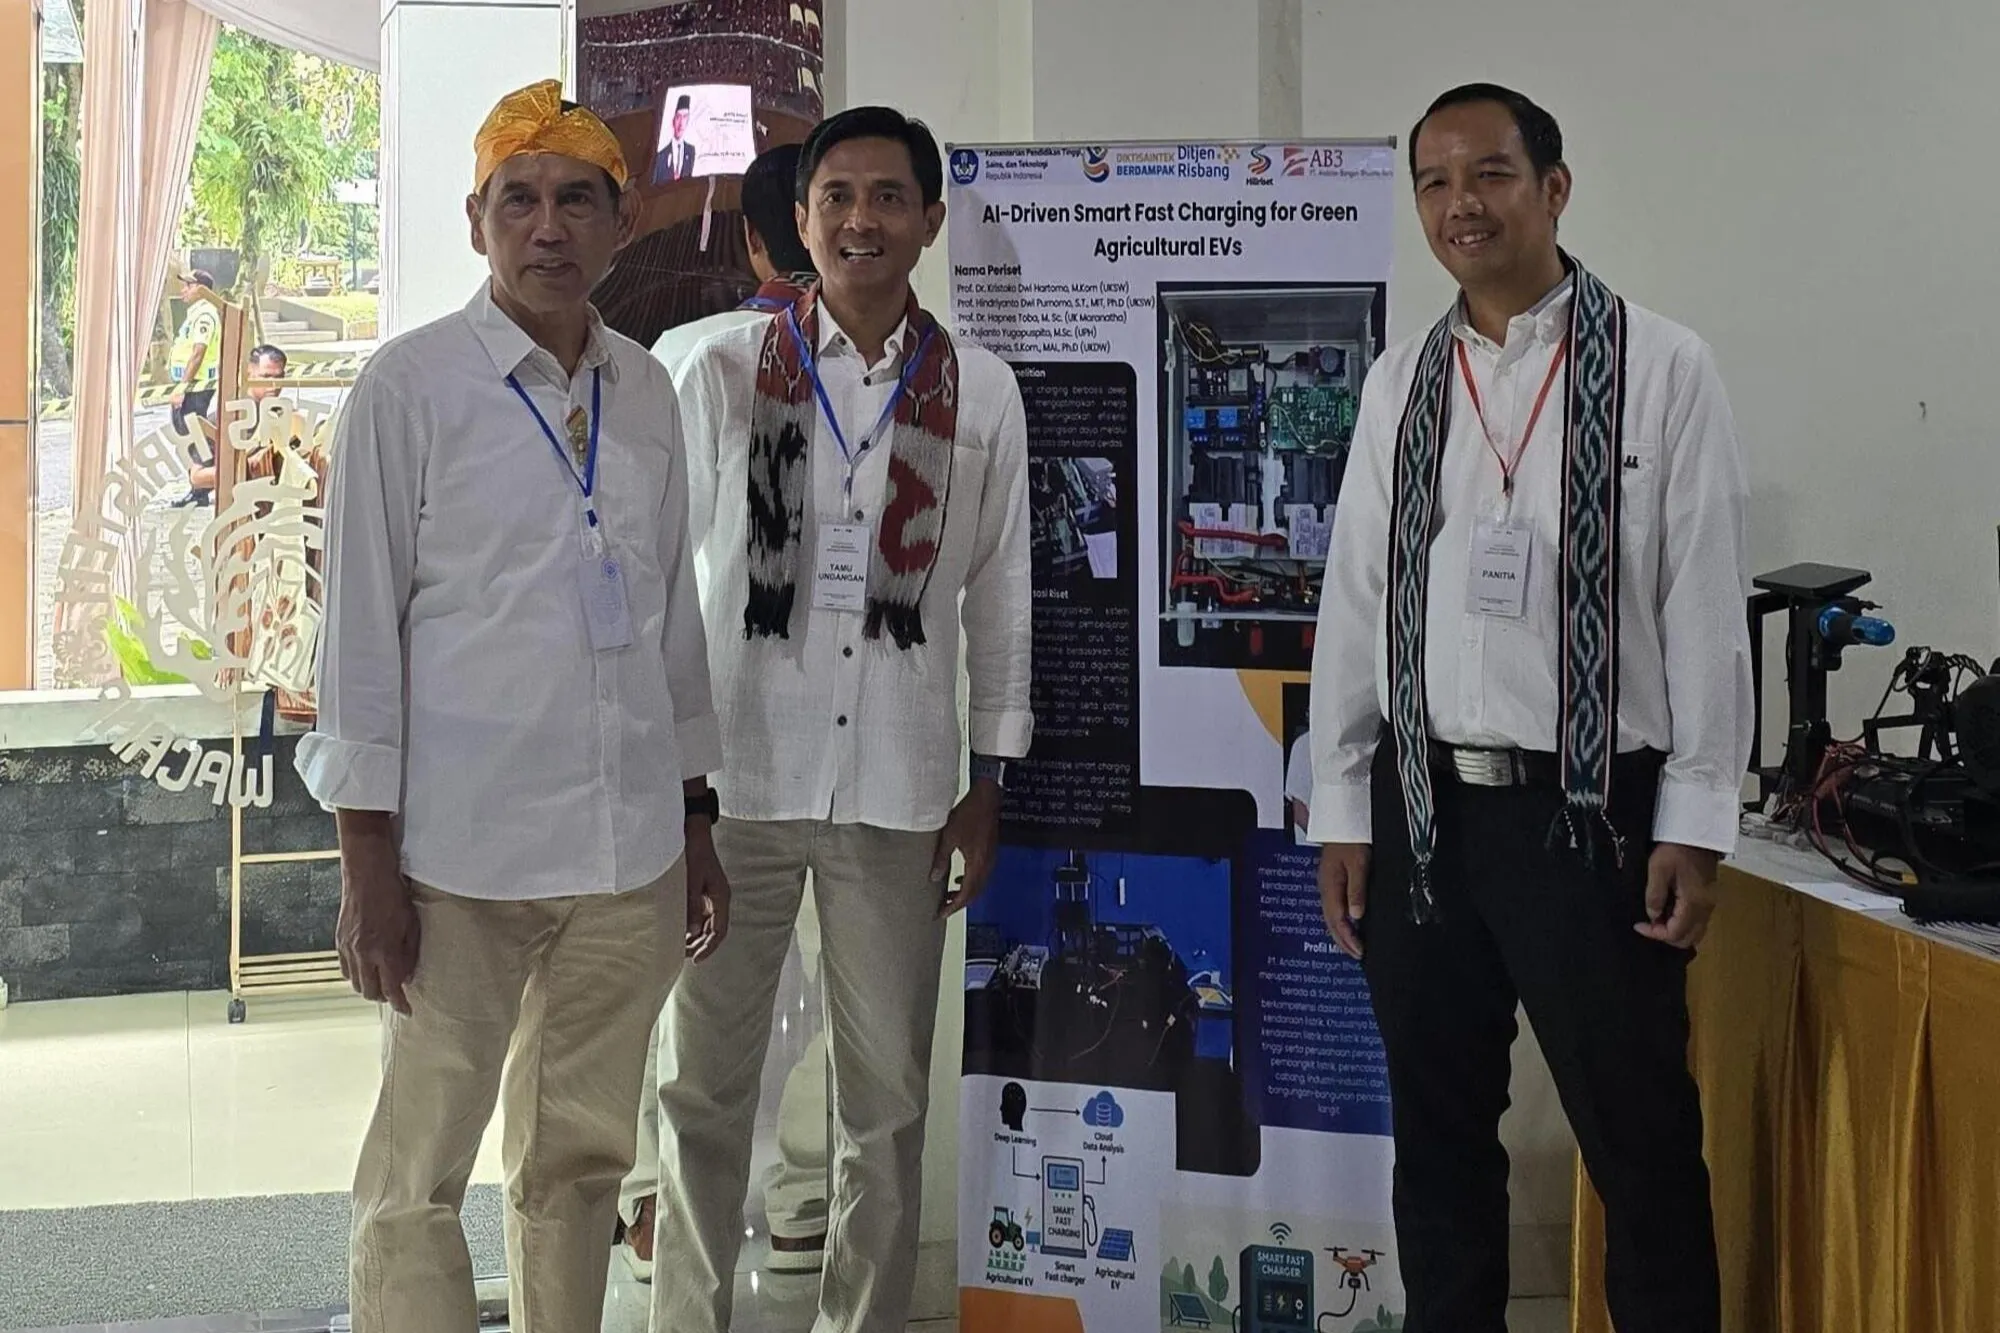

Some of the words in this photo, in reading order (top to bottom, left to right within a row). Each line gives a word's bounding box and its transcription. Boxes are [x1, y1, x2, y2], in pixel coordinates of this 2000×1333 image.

[1116, 152, 1175, 163] DIKTISAINTEK
[1177, 145, 1215, 163] Ditjen
[1309, 149, 1343, 168] AB3
[1116, 164, 1175, 176] BERDAMPAK
[1177, 164, 1230, 181] Risbang
[982, 202, 1070, 222] AI-Driven
[1074, 203, 1131, 222] Smart
[1135, 202, 1174, 222] Fast
[1178, 201, 1266, 227] Charging
[1270, 201, 1296, 221] for
[1301, 202, 1358, 222] Green
[1094, 236, 1205, 262] Agricultural
[1209, 237, 1242, 256] EVs
[955, 264, 986, 276] Nama
[988, 263, 1022, 276] Periset
[829, 563, 853, 573] TAMU
[818, 572, 865, 583] UNDANGAN
[1482, 569, 1516, 581] PANITIA
[1094, 1132, 1113, 1142] Cloud
[1083, 1141, 1098, 1151] Data
[1257, 1250, 1285, 1264] SMART
[1286, 1254, 1305, 1266] FAST
[1054, 1260, 1076, 1273] Smart
[1261, 1264, 1302, 1277] CHARGER
